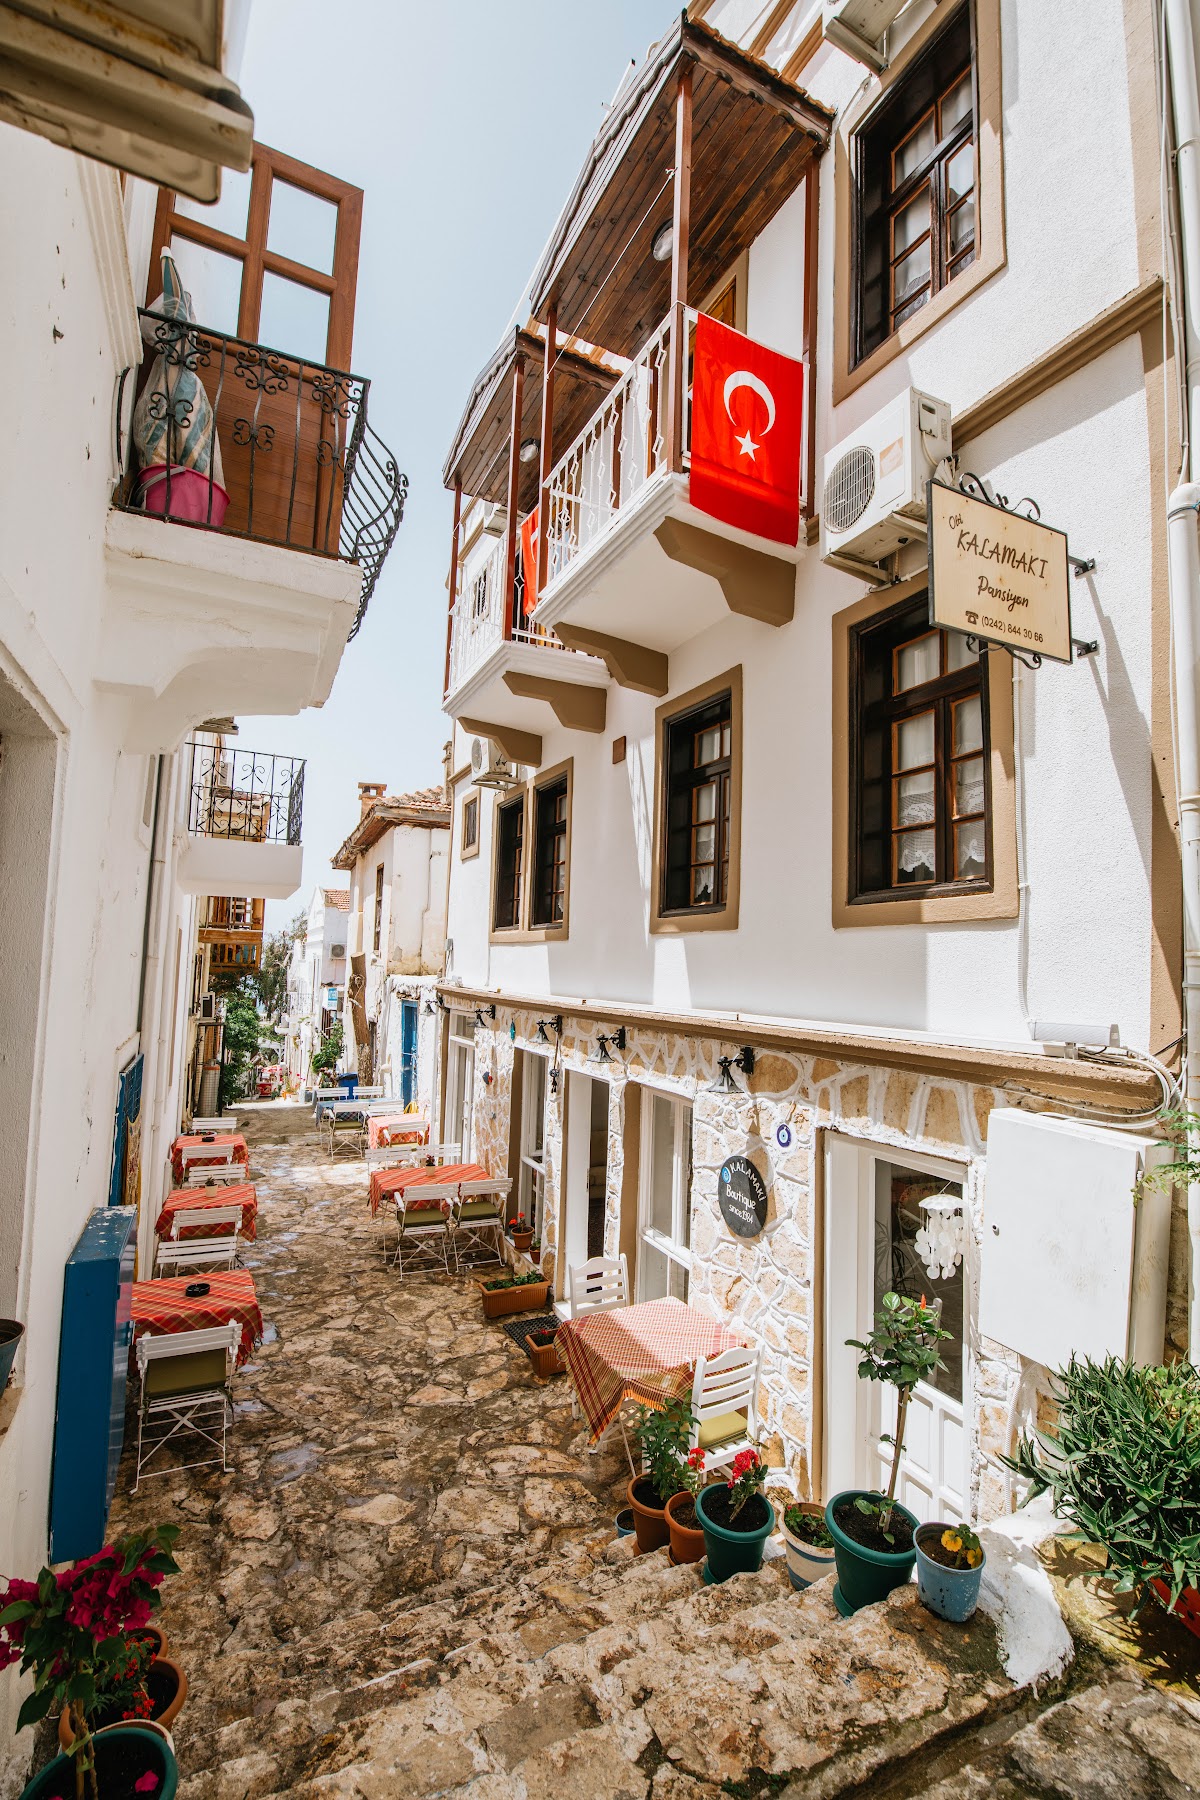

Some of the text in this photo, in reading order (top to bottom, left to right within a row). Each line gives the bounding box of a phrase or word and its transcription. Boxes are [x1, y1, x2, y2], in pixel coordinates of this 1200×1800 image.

[949, 513, 963, 530] Old
[957, 529, 1049, 579] KALAMAKI
[977, 575, 1029, 612] Pansiyon
[981, 615, 1044, 643] (0242) 844 30 66
[726, 1183, 757, 1210] Boutique
